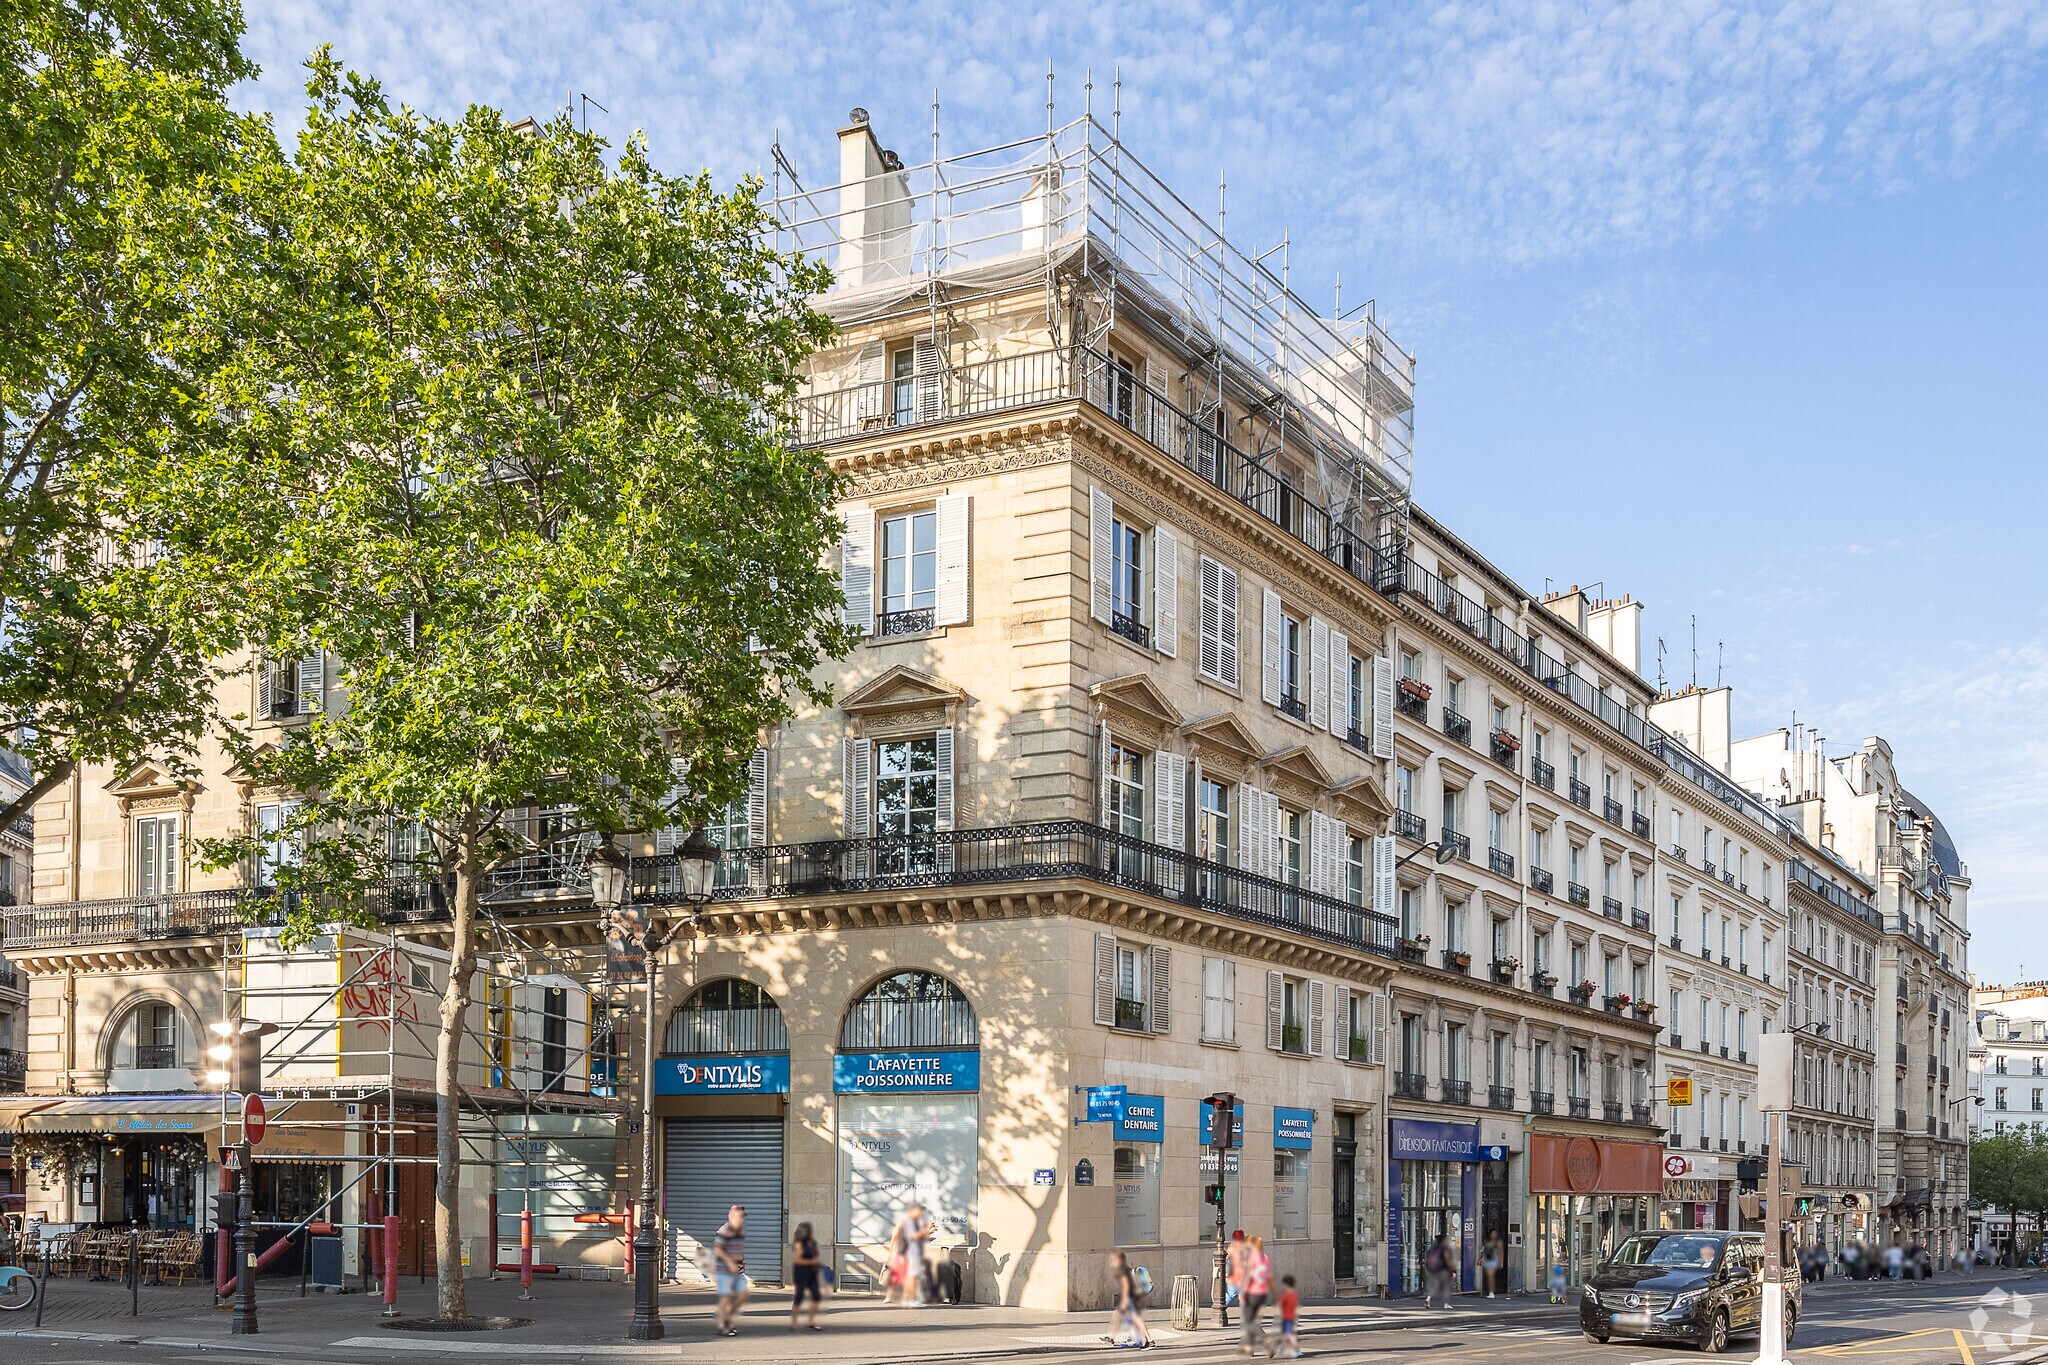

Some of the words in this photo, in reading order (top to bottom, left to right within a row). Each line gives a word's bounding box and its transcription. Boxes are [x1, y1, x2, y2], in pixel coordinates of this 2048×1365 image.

[869, 1058, 940, 1071] LAFAYETTE
[683, 1065, 762, 1084] DENTYLIS
[856, 1072, 953, 1087] POISSONNIÈRE
[1128, 1106, 1155, 1117] CENTRE
[128, 1120, 153, 1129] Atelier
[155, 1120, 168, 1129] des
[1124, 1120, 1159, 1131] DENTAIRE
[1282, 1119, 1308, 1128] LAFAYETTE
[275, 1128, 286, 1137] des
[1278, 1130, 1312, 1139] POISSONNIÈRE
[1398, 1129, 1406, 1137] LA
[507, 1142, 547, 1151] DNYLIS
[851, 1141, 891, 1150] DNTYLIS
[1398, 1137, 1431, 1152] DIMENSION
[1432, 1139, 1474, 1154] FANTASTIQUE
[1199, 1163, 1207, 1171] 01
[1207, 1163, 1215, 1171] 83
[1230, 1164, 1238, 1172] 45
[880, 1183, 903, 1191] CENTRE
[904, 1183, 933, 1191] DENTAIRE
[1464, 1222, 1475, 1232] BD
